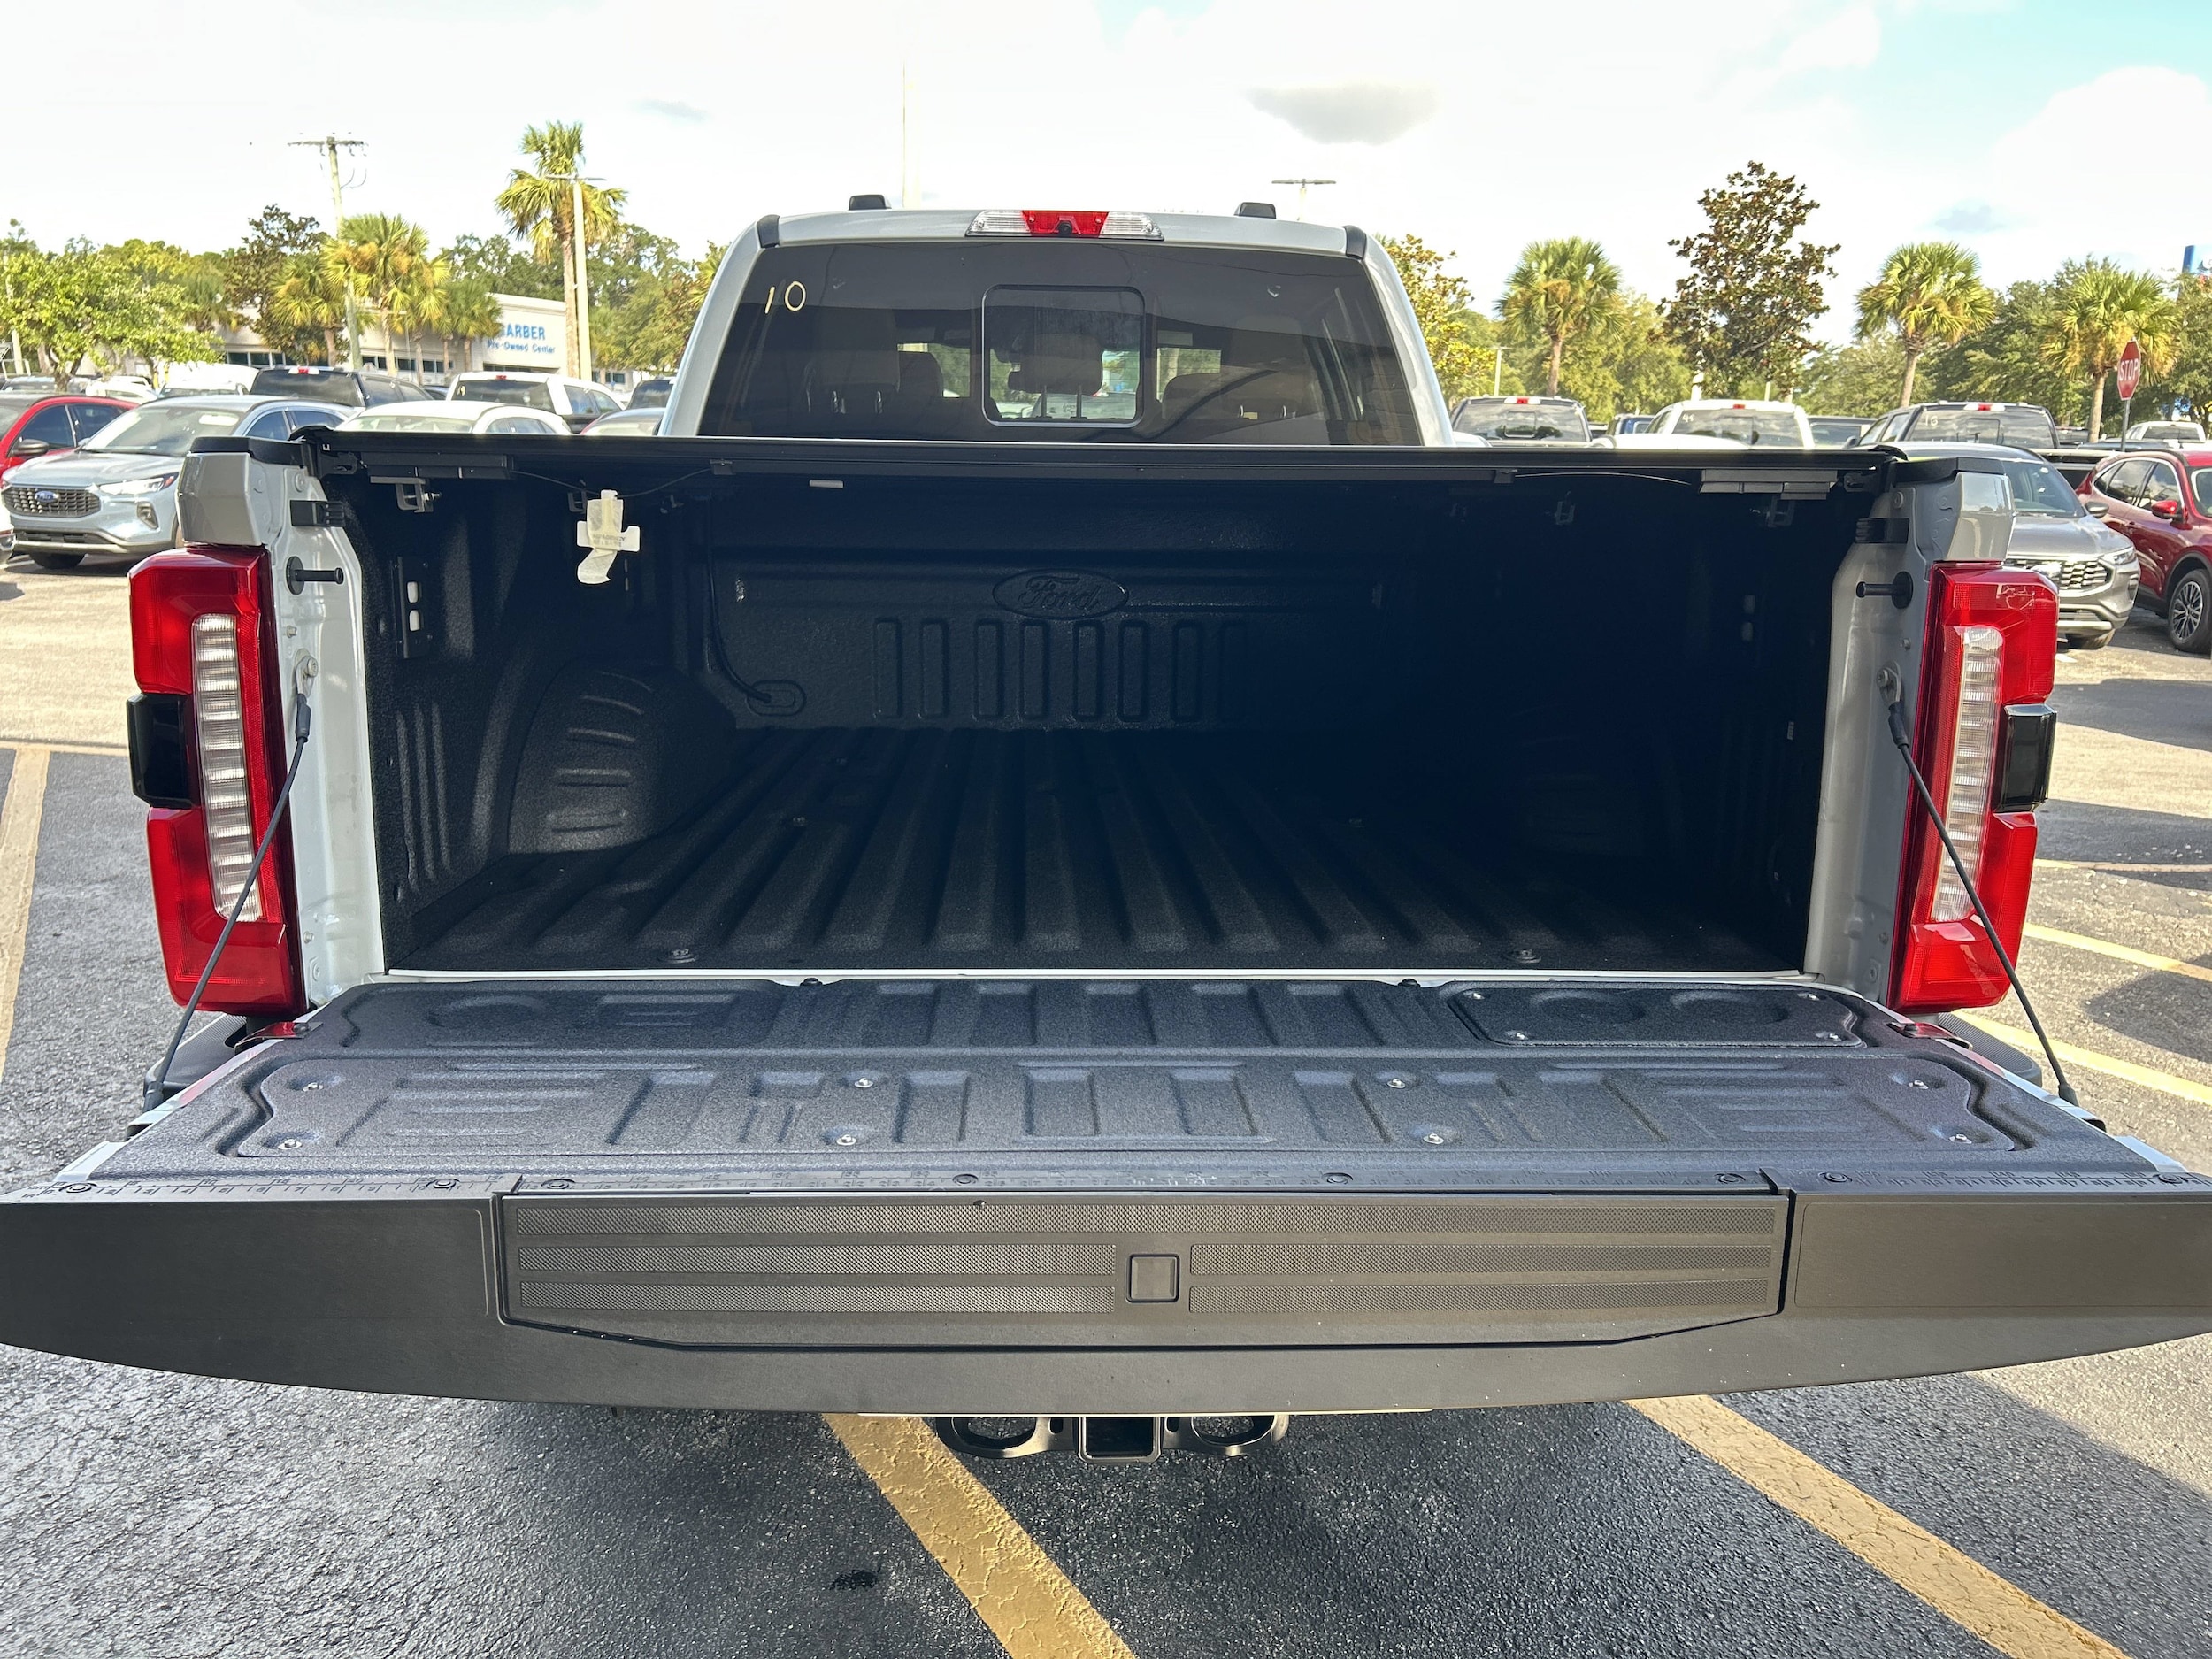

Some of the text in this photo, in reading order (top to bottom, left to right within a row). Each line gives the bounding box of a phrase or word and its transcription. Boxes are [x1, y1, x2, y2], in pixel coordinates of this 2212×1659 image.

[764, 280, 807, 314] 10
[502, 323, 546, 341] ARBER
[488, 340, 557, 354] Pre-Owned Center
[2119, 357, 2139, 382] STOP
[1018, 574, 1102, 611] Ford
